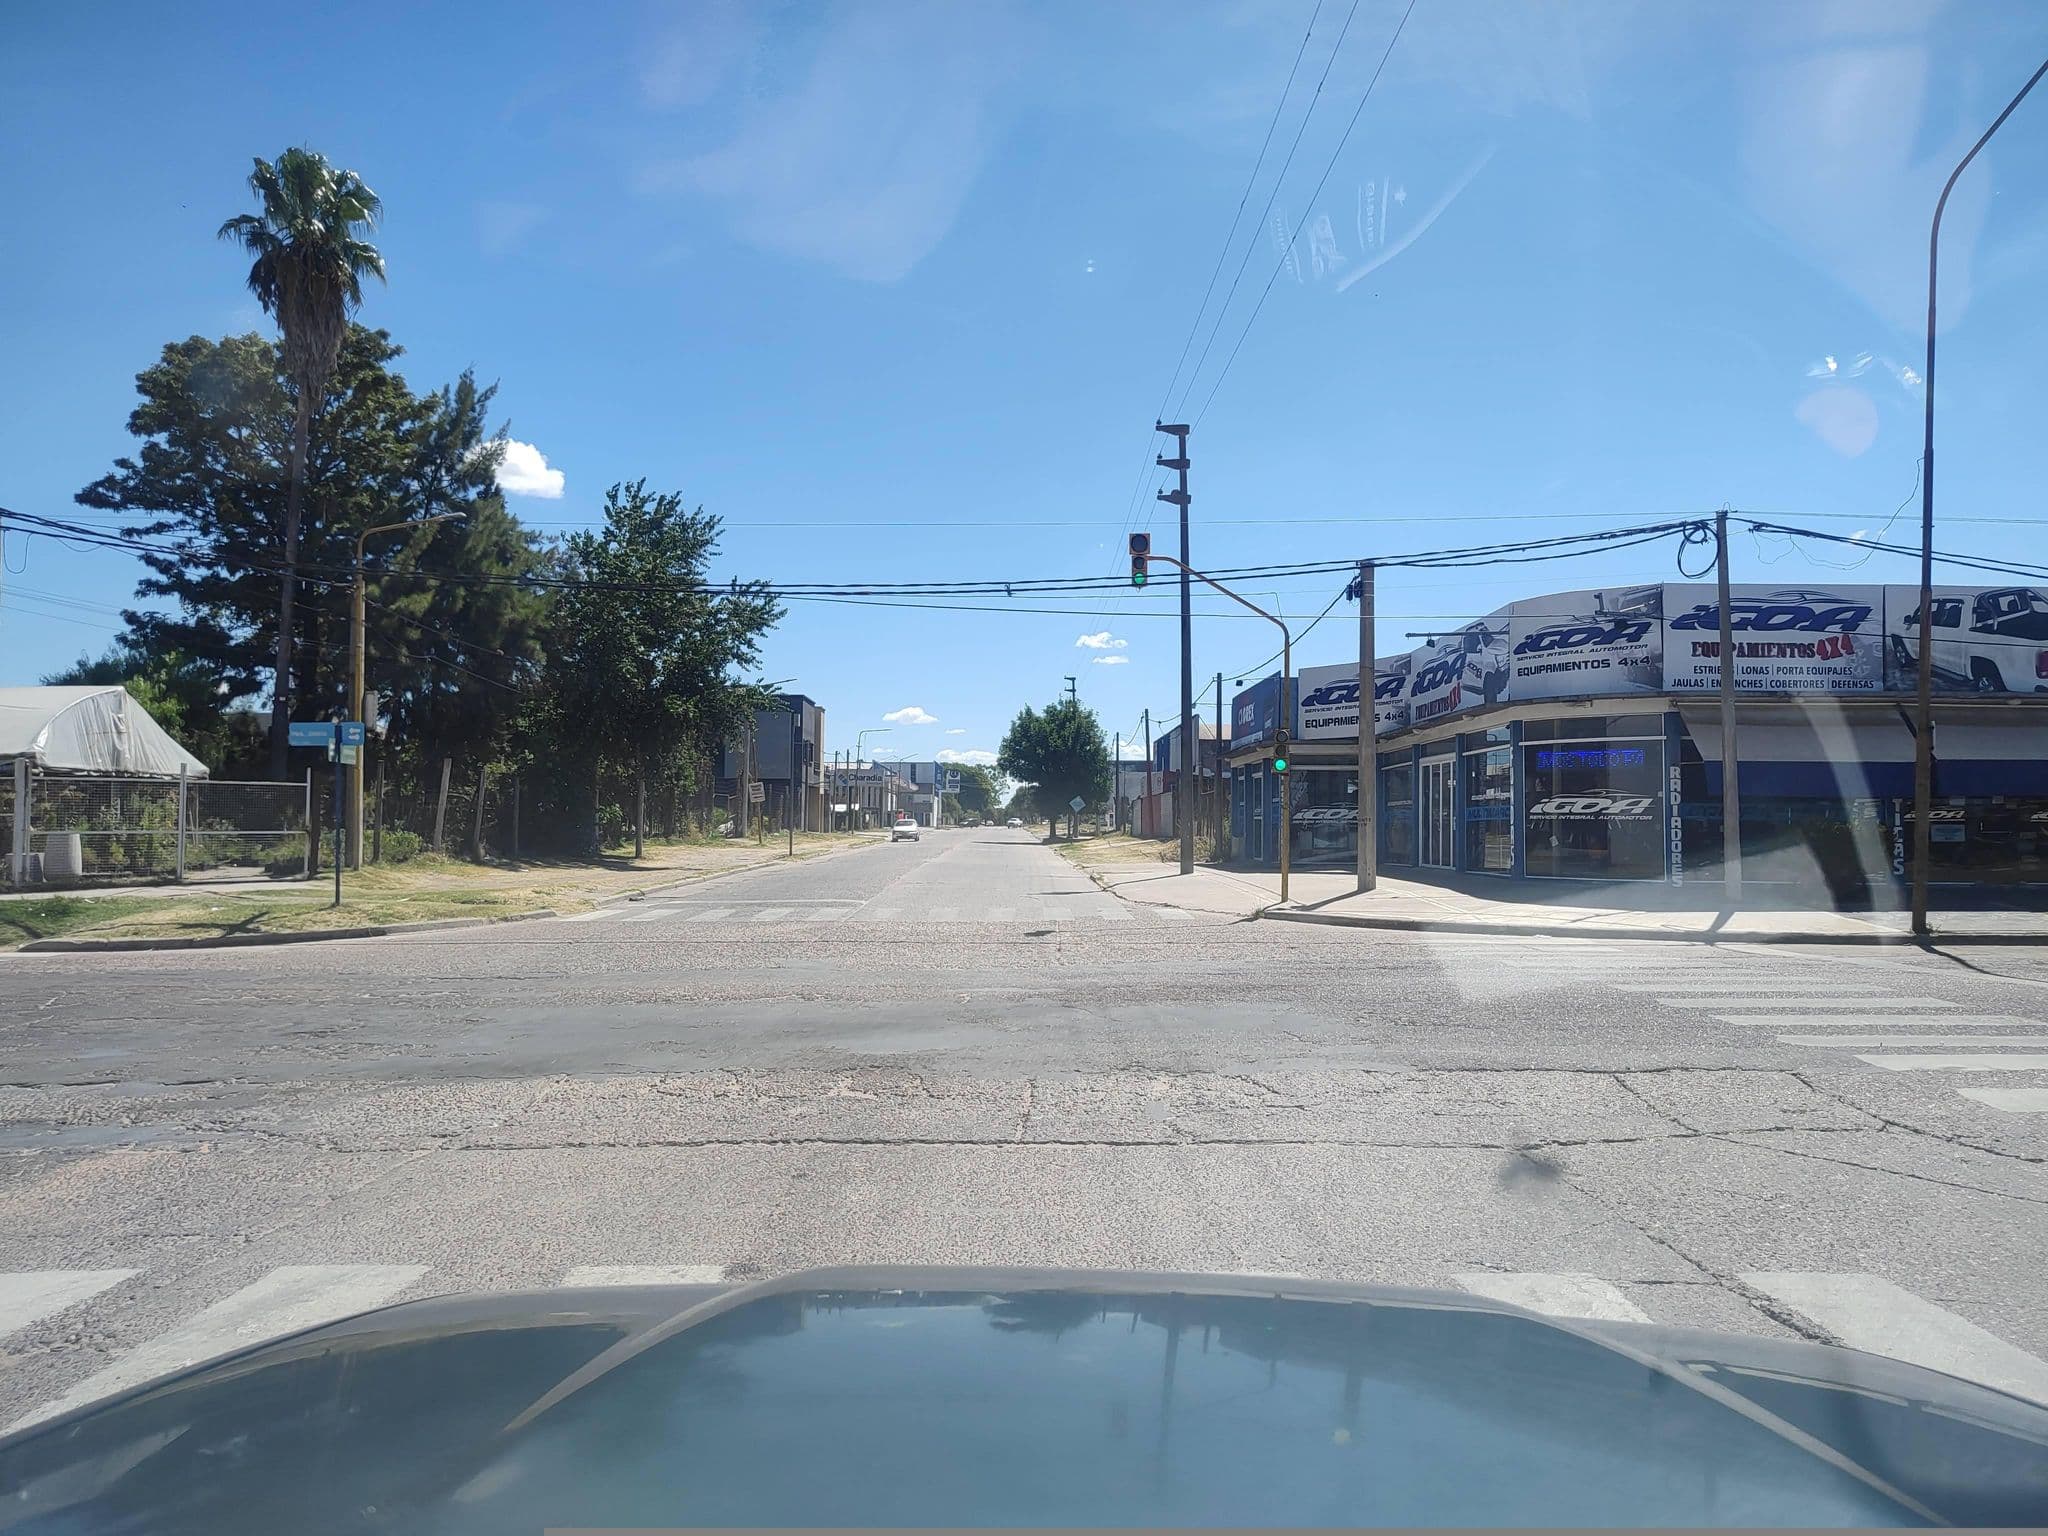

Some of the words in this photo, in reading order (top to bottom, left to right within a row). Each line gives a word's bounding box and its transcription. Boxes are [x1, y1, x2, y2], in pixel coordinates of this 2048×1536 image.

[1546, 650, 1585, 658] INTEGRAL
[1589, 643, 1649, 653] AUTOMOTOR
[1691, 641, 1815, 658] EQUPAMIENTOS
[1517, 659, 1611, 677] EQUIPAMIENTOS
[1617, 655, 1651, 667] 4x4
[1741, 665, 1770, 675] LONAS
[1776, 666, 1805, 675] PORTA
[1806, 666, 1853, 676] EQUIPAJES
[1671, 678, 1705, 688] JAULAS
[1711, 678, 1764, 689] ENNCHES
[1769, 679, 1825, 689] COBERTORES
[1831, 679, 1875, 689] DEFENSAS
[1669, 766, 1683, 888] RADIADORES
